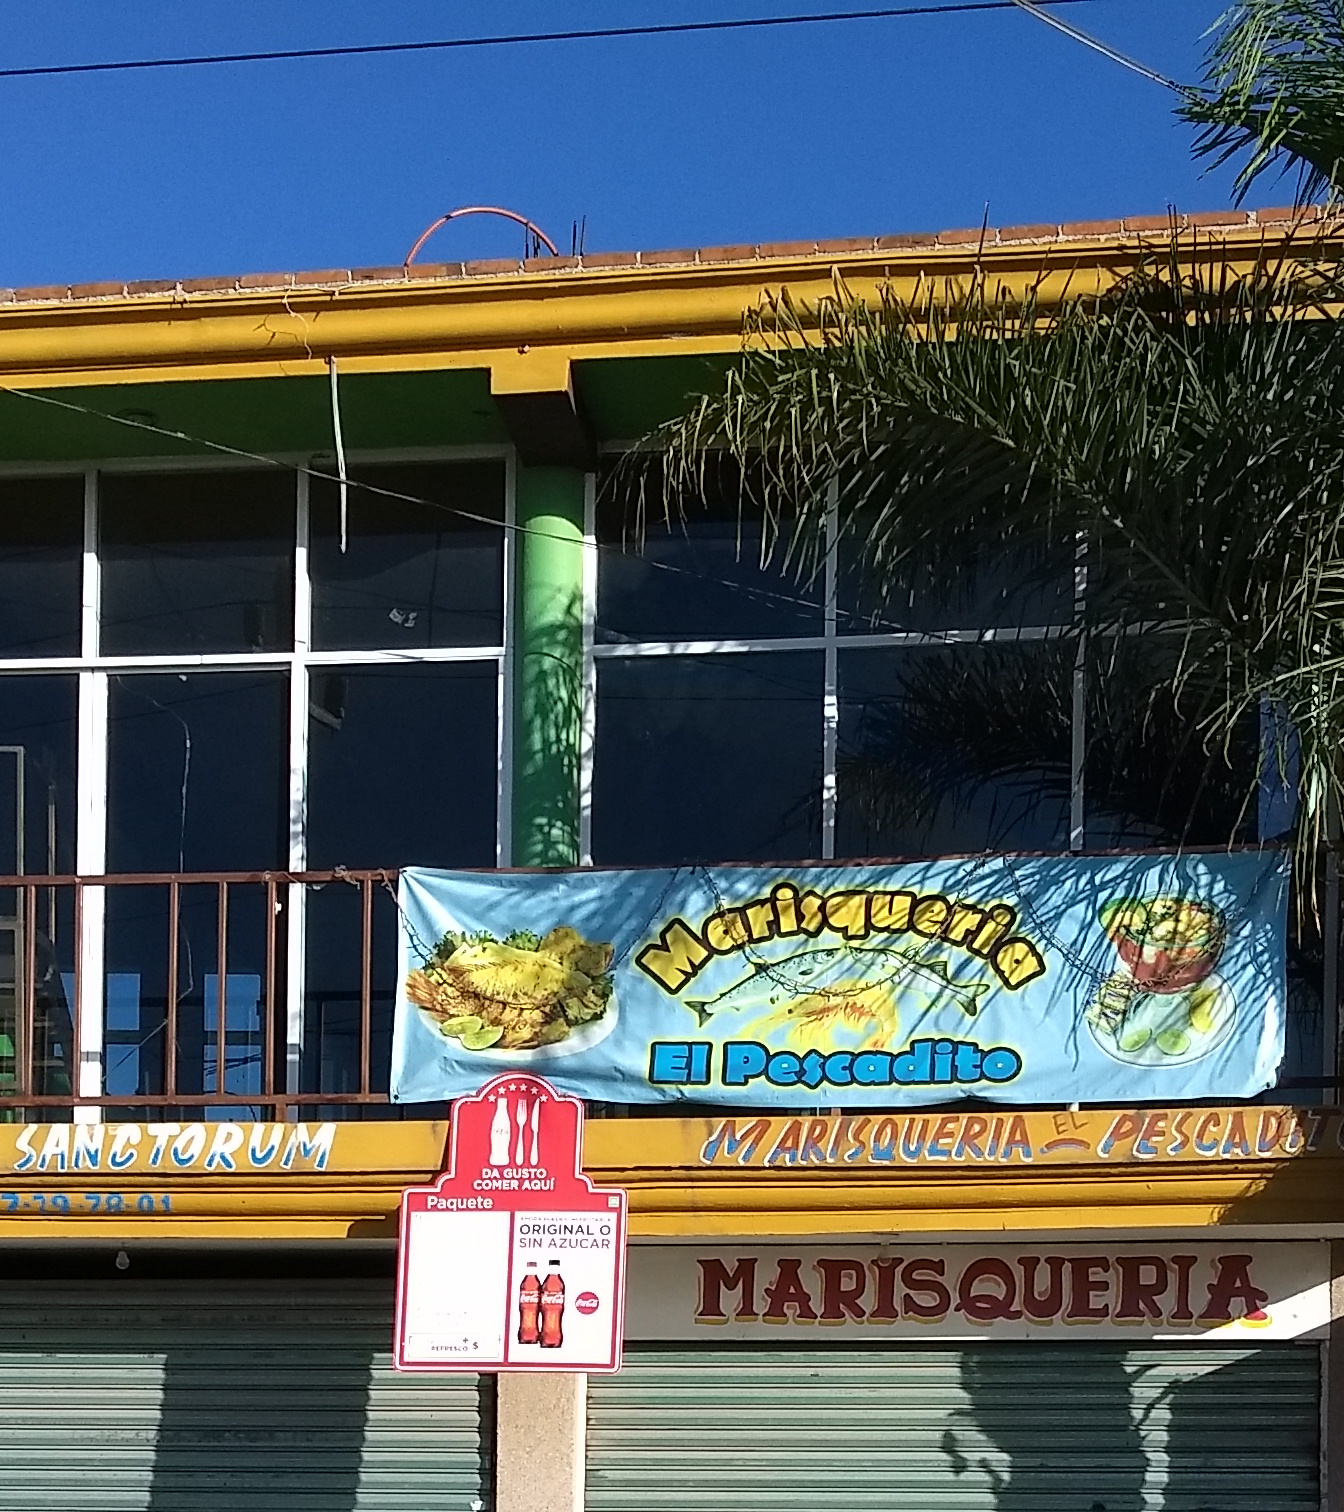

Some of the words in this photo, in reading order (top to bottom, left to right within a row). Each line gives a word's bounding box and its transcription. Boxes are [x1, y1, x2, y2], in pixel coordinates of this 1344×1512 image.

[635, 882, 1046, 995] Marisqueria
[649, 1042, 713, 1085] El
[722, 1039, 1022, 1088] Pescadito
[13, 1122, 337, 1173] SANCTORUM
[701, 1115, 1034, 1166] MARISQUERIA
[1052, 1111, 1089, 1137] EL
[473, 1180, 520, 1190] COMER
[522, 1178, 555, 1190] AQUÍ
[482, 1169, 500, 1179] DA
[504, 1169, 547, 1179] GUSTO
[427, 1196, 493, 1211] Paquete
[519, 1224, 594, 1236] ORIGINAL
[600, 1225, 611, 1235] O
[519, 1238, 542, 1248] SIN
[548, 1239, 610, 1249] AZUCAR
[694, 1254, 1273, 1329] MARISQUERIA
